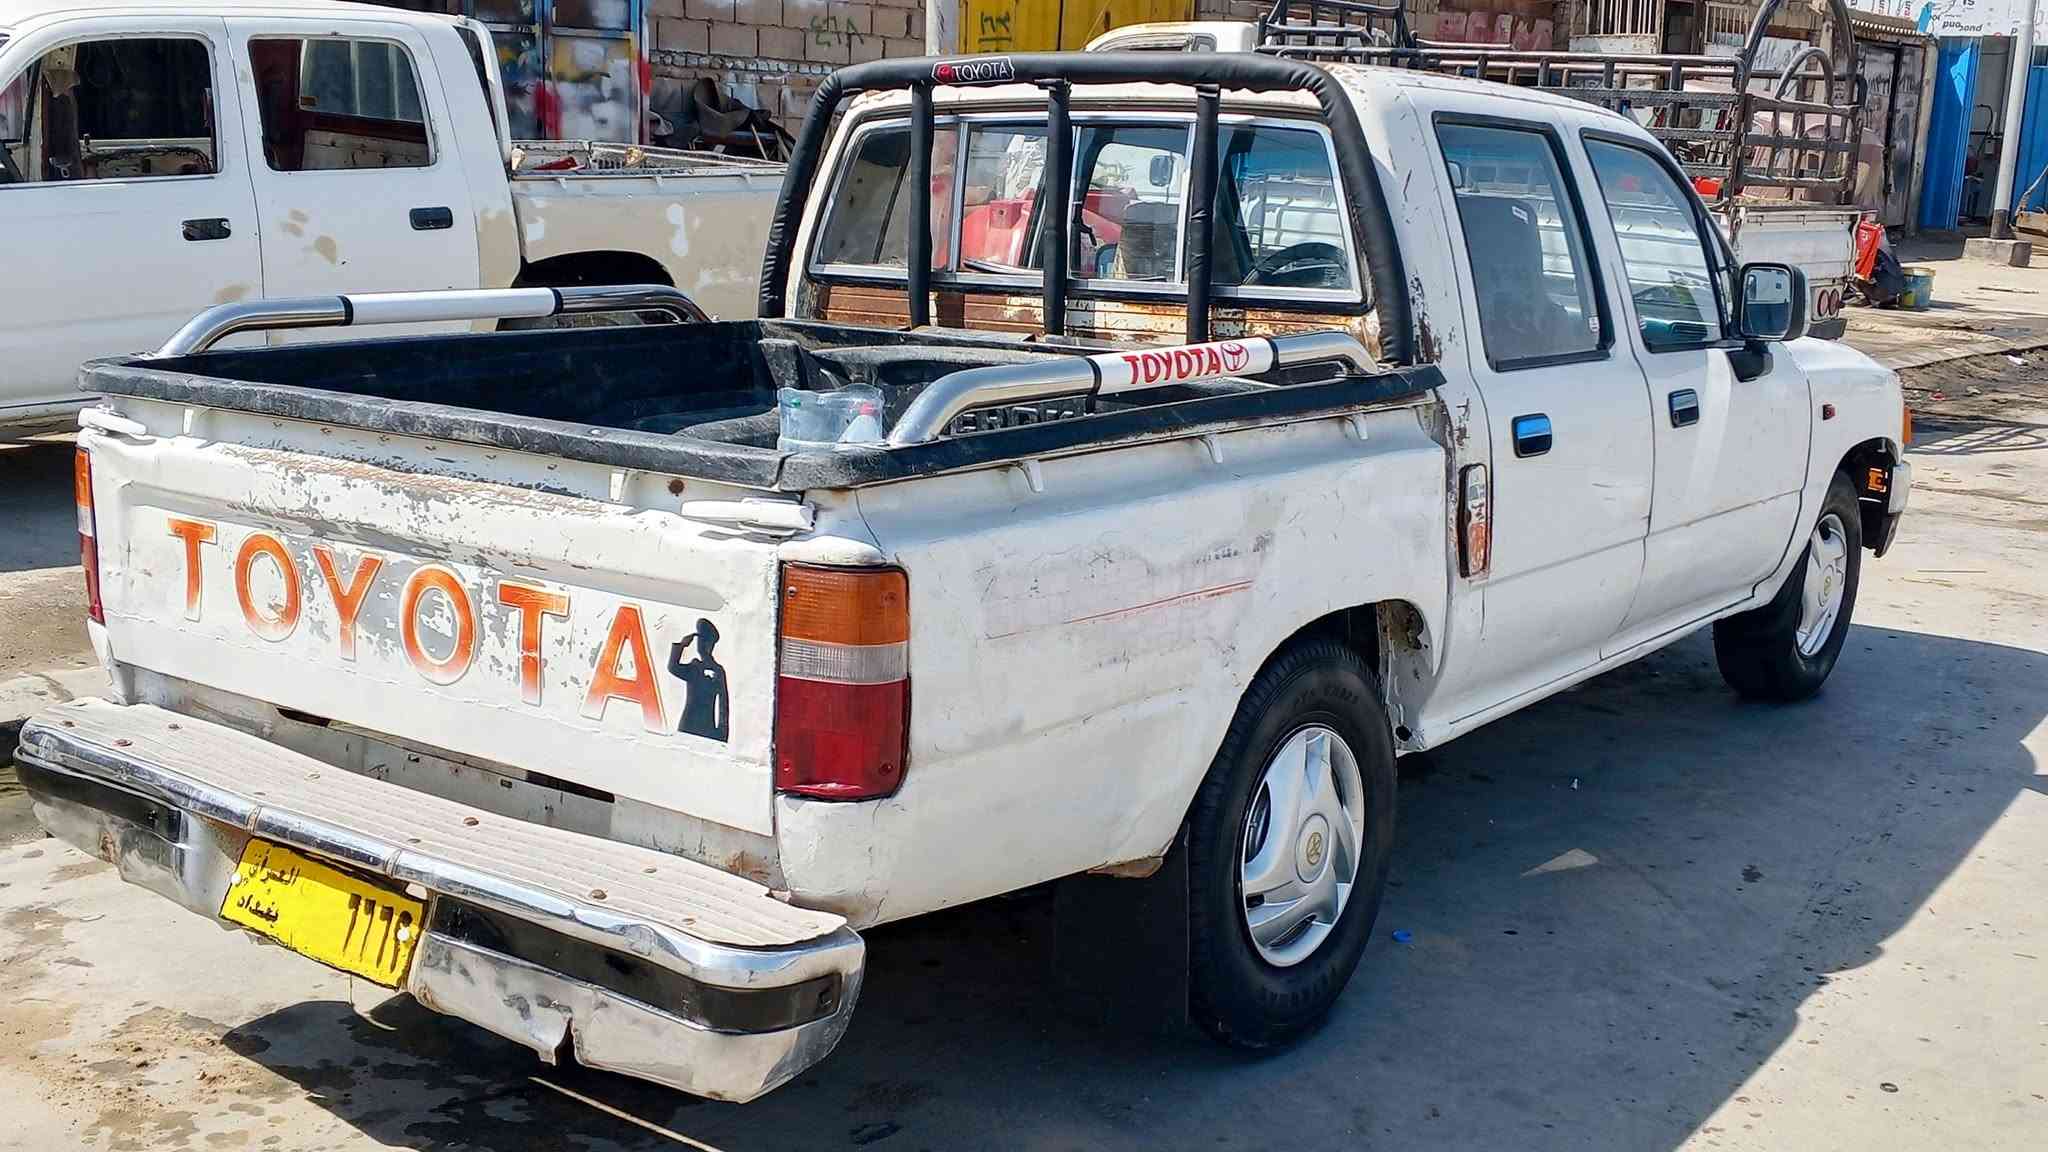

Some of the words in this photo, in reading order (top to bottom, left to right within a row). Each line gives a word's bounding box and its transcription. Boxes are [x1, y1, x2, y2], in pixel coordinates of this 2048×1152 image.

[952, 61, 1009, 81] TOYOTA
[1121, 347, 1222, 385] TOYOTA
[166, 516, 674, 737] TOYOTA
[237, 894, 280, 929] بغداد
